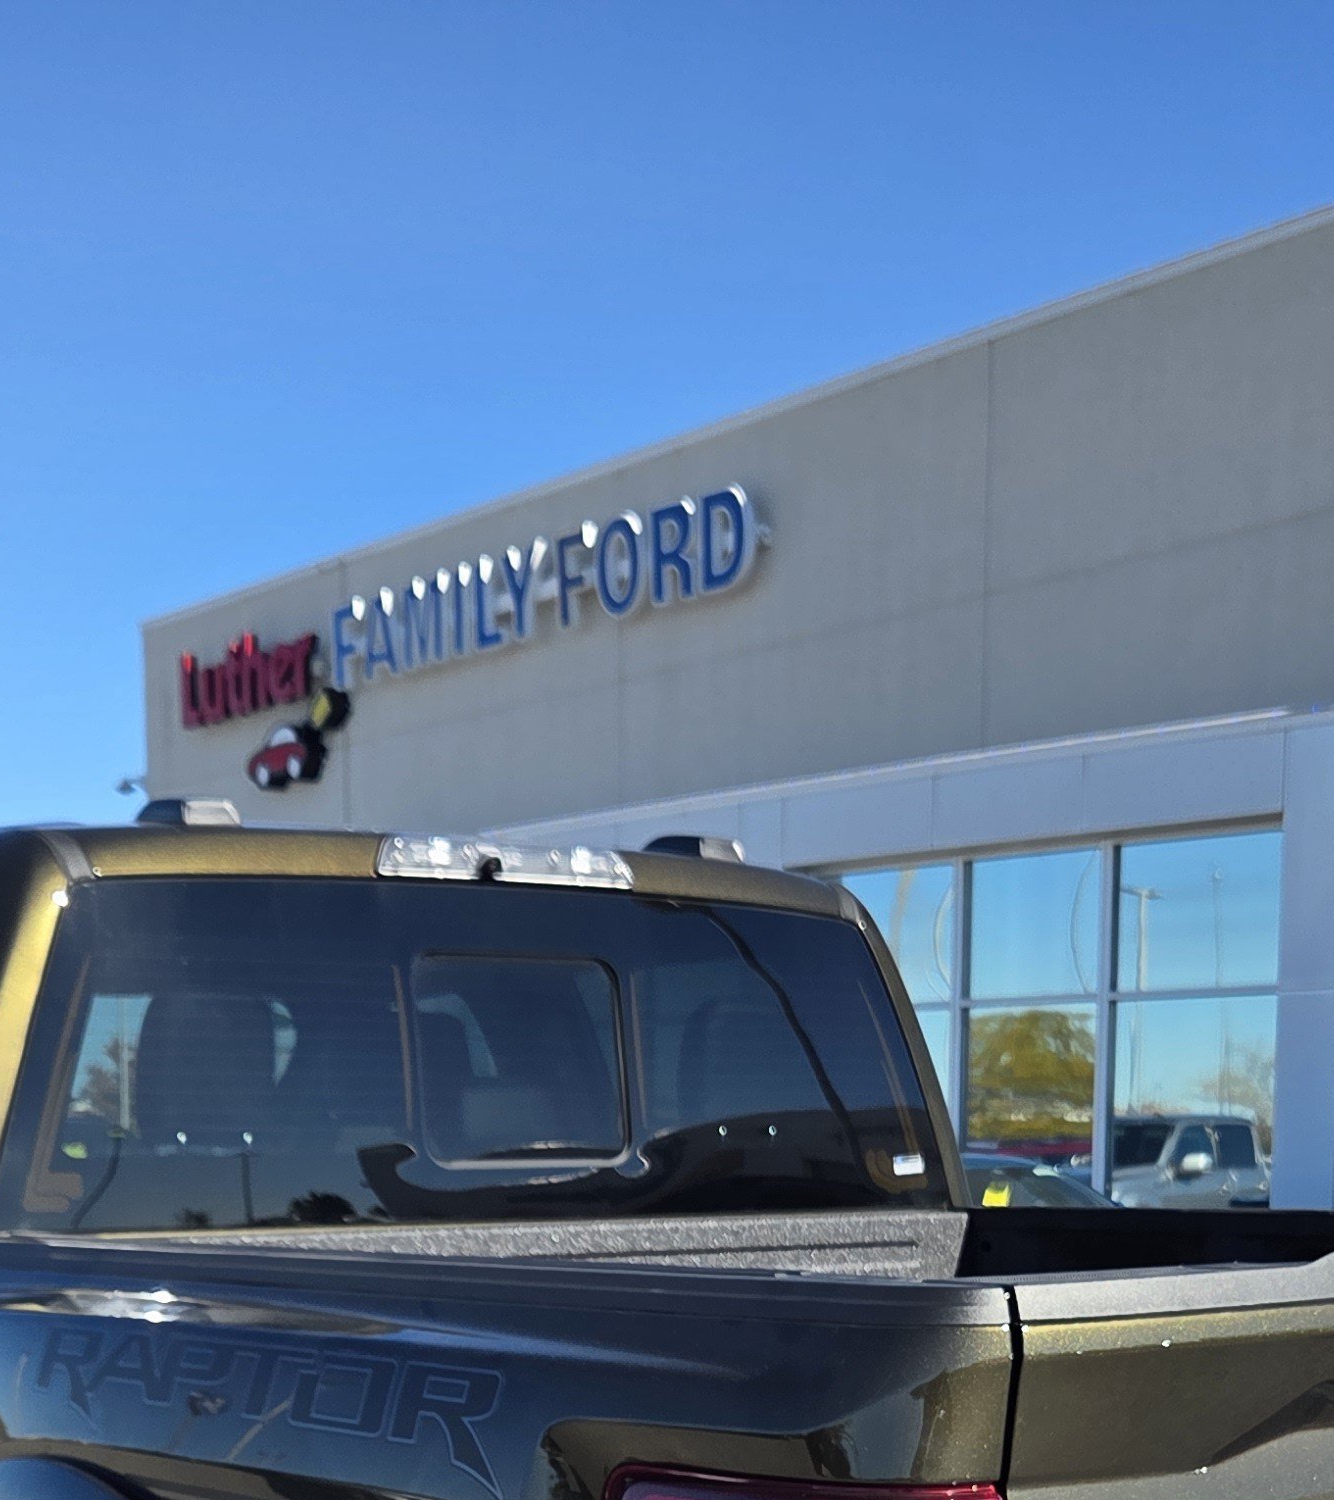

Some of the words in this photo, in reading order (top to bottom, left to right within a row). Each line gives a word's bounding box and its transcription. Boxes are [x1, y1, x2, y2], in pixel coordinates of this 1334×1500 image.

[179, 630, 317, 728] Luther
[331, 536, 548, 686] FAMILY
[557, 484, 752, 628] FORD
